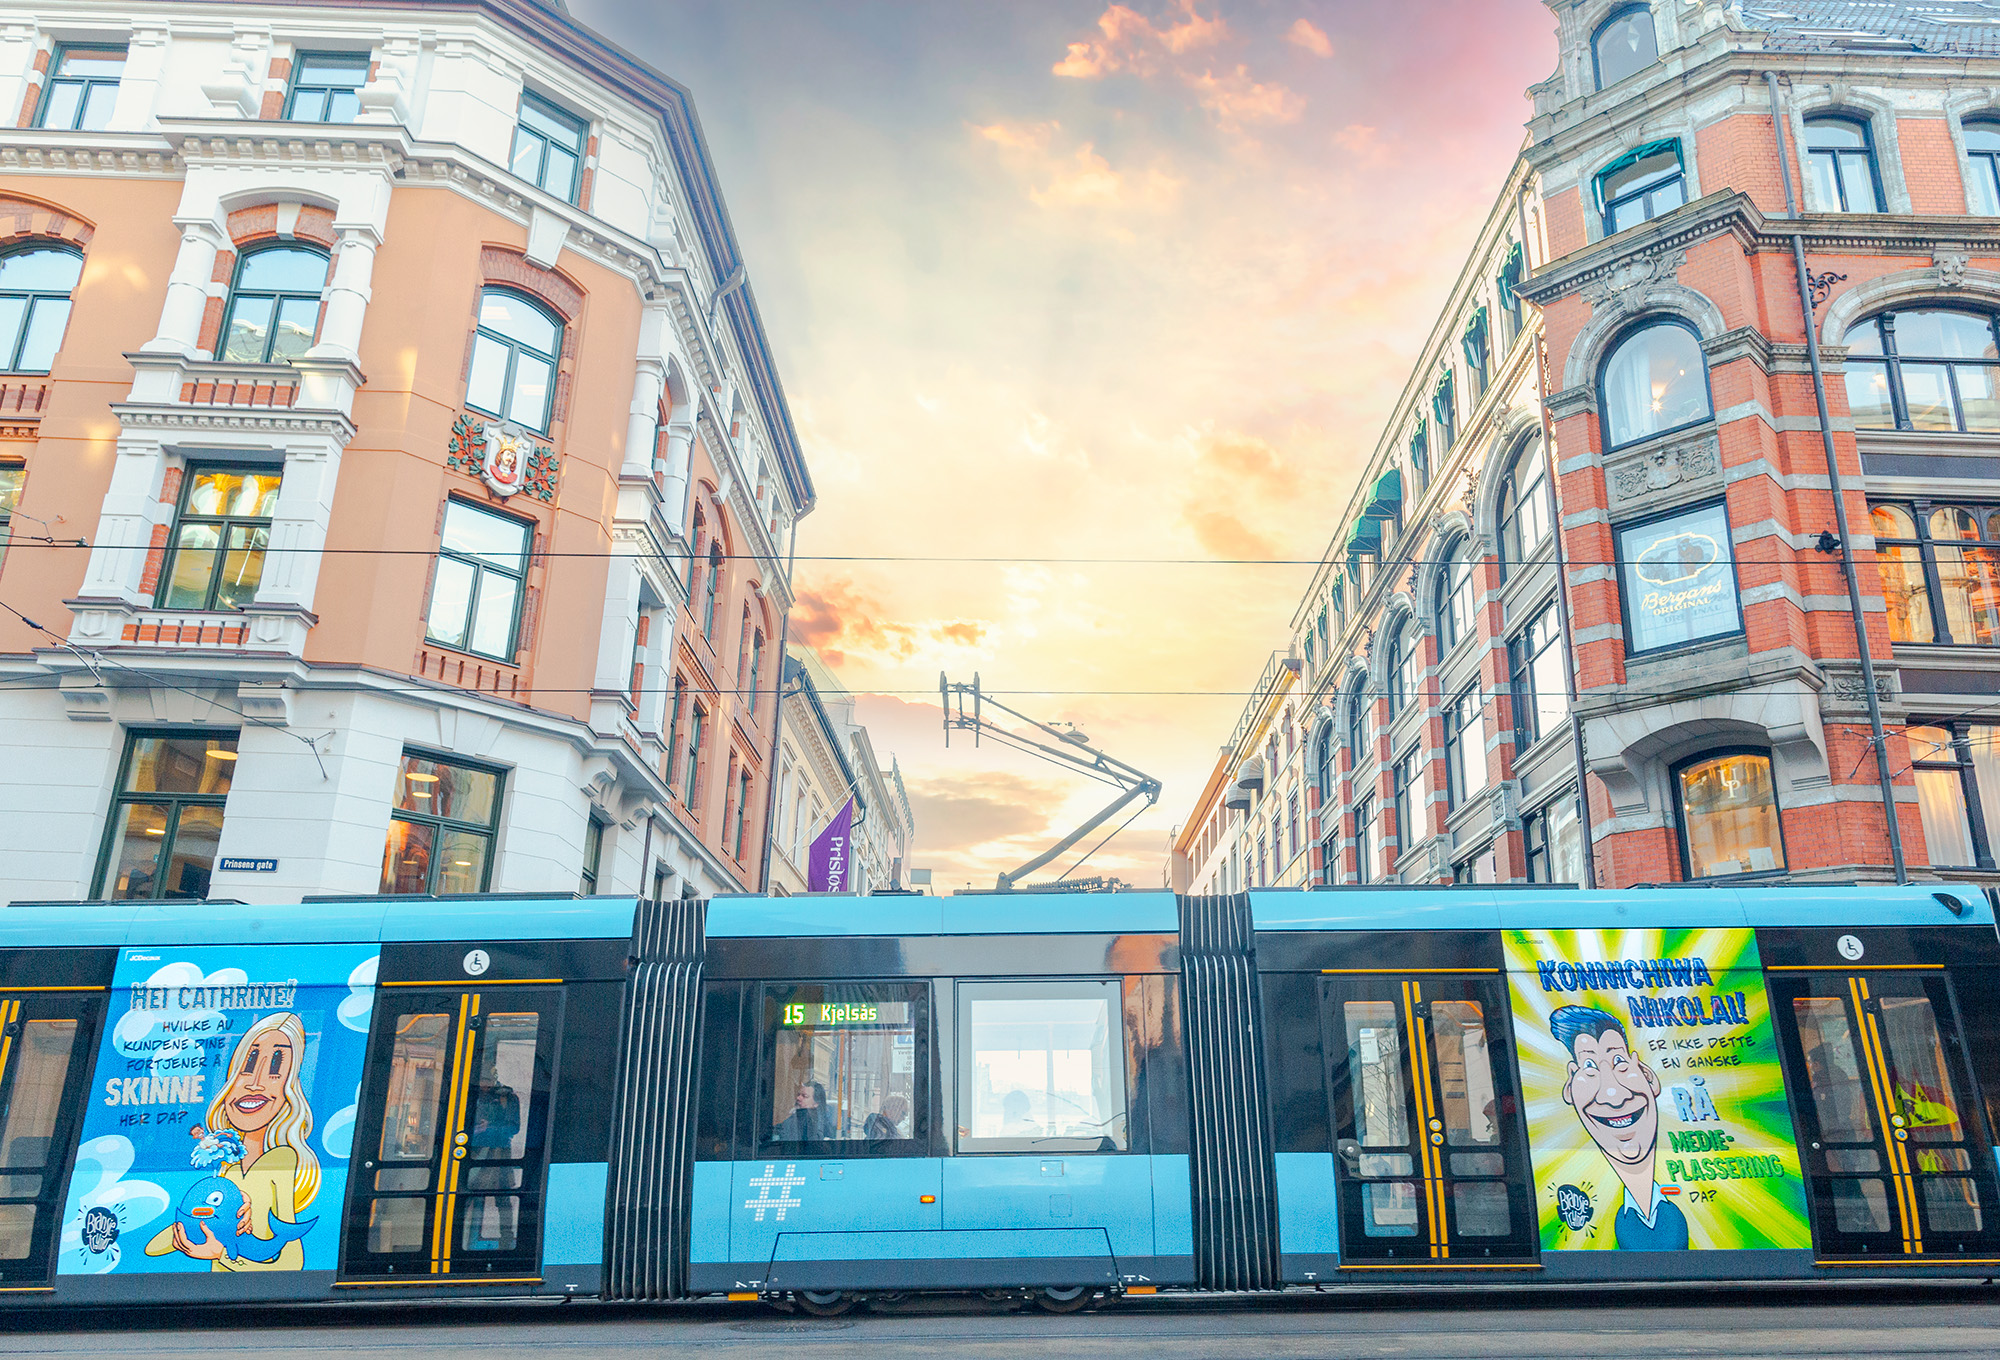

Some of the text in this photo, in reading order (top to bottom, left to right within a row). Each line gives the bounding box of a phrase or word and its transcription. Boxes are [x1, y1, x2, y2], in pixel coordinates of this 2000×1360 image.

[1641, 579, 1722, 611] Bergans
[1653, 597, 1711, 615] ORIGINAL
[223, 859, 273, 871] Prinsens gate
[1536, 957, 1714, 991] KONNICHIWA
[130, 978, 298, 1010] HEI CATHRINE!
[783, 1003, 877, 1025] 15 Kjelsås
[1627, 992, 1749, 1028] NIKOLAI!
[162, 1020, 211, 1033] HVILKE
[123, 1037, 226, 1052] KUNDENE DINE
[1648, 1035, 1756, 1051] ER IKKE DETTE
[126, 1054, 221, 1071] FORTJENER Å
[1661, 1054, 1742, 1069] EN GANSKE
[104, 1075, 205, 1106] SKINNE
[1671, 1074, 1720, 1122] RÅ
[119, 1110, 188, 1127] HER DA?
[1667, 1129, 1735, 1153] MEDIE-
[1666, 1154, 1784, 1182] PLASSERING
[1689, 1189, 1717, 1203] DA?
